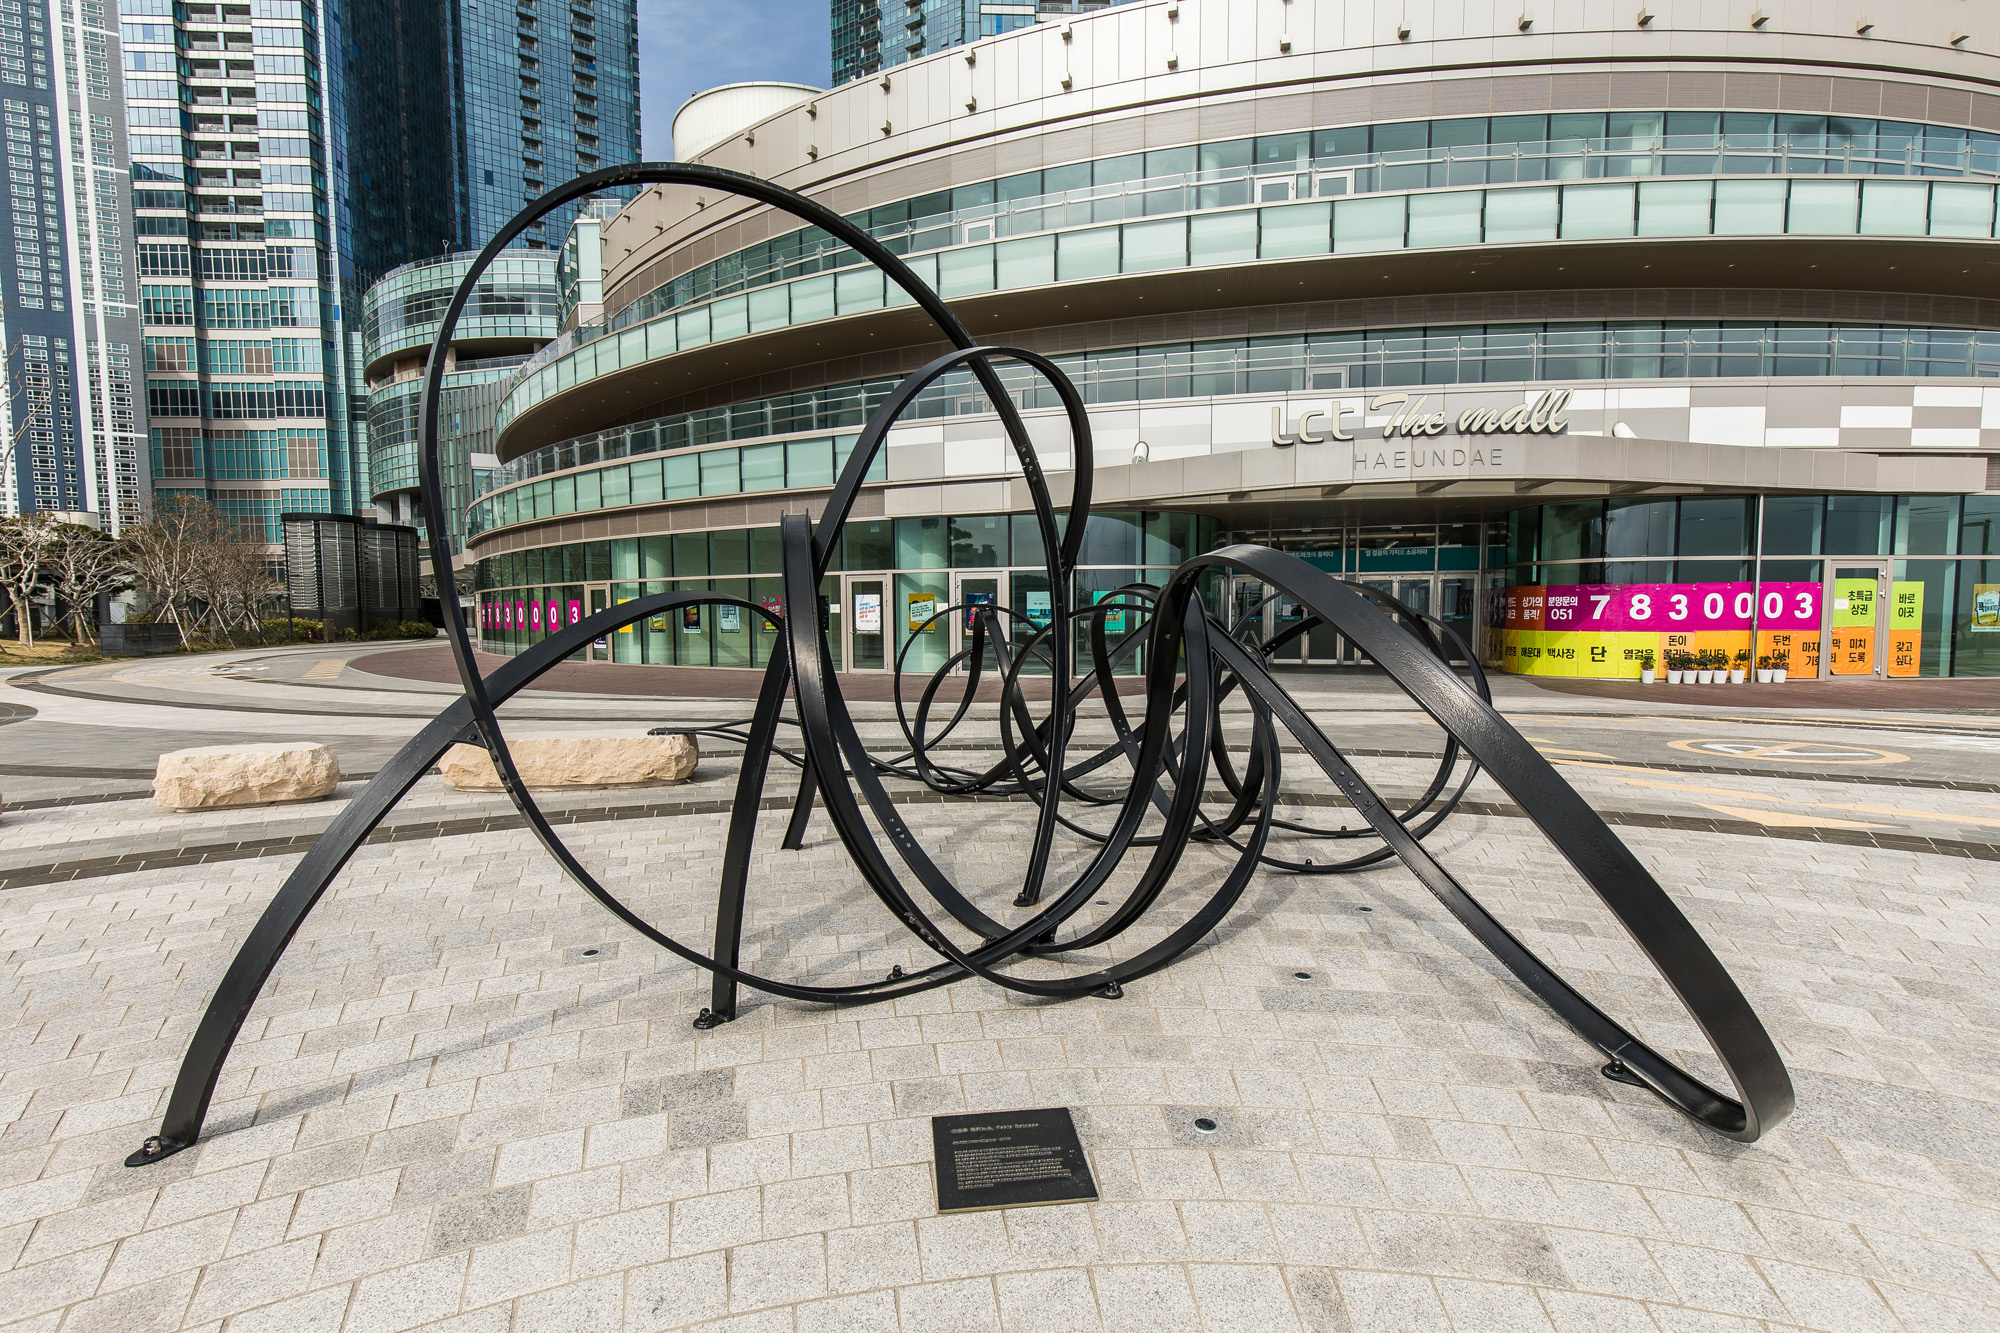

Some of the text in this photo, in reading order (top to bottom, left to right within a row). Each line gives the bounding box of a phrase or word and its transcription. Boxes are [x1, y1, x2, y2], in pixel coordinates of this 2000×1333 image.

[1370, 393, 1447, 438] The
[1458, 388, 1574, 434] mall
[1354, 448, 1502, 470] HAEUNDAE
[1522, 596, 1543, 607] 상가의
[1548, 596, 1578, 607] 분양문의
[1848, 591, 1873, 601] 초특급
[1898, 594, 1915, 604] 바로
[1523, 609, 1540, 620] 품격!
[1551, 609, 1573, 620] 051
[1851, 604, 1868, 615] 상권
[1897, 607, 1915, 618] 이곳
[1668, 635, 1687, 646] 돈이
[1773, 635, 1791, 646] 두번
[1850, 638, 1866, 649] 미치
[1896, 641, 1912, 652] 갖고
[1521, 647, 1541, 658] 해운대
[1547, 648, 1575, 659] 백사장
[1590, 646, 1607, 662] 단
[1849, 652, 1866, 662] 도록
[1895, 655, 1912, 666] 싶다
